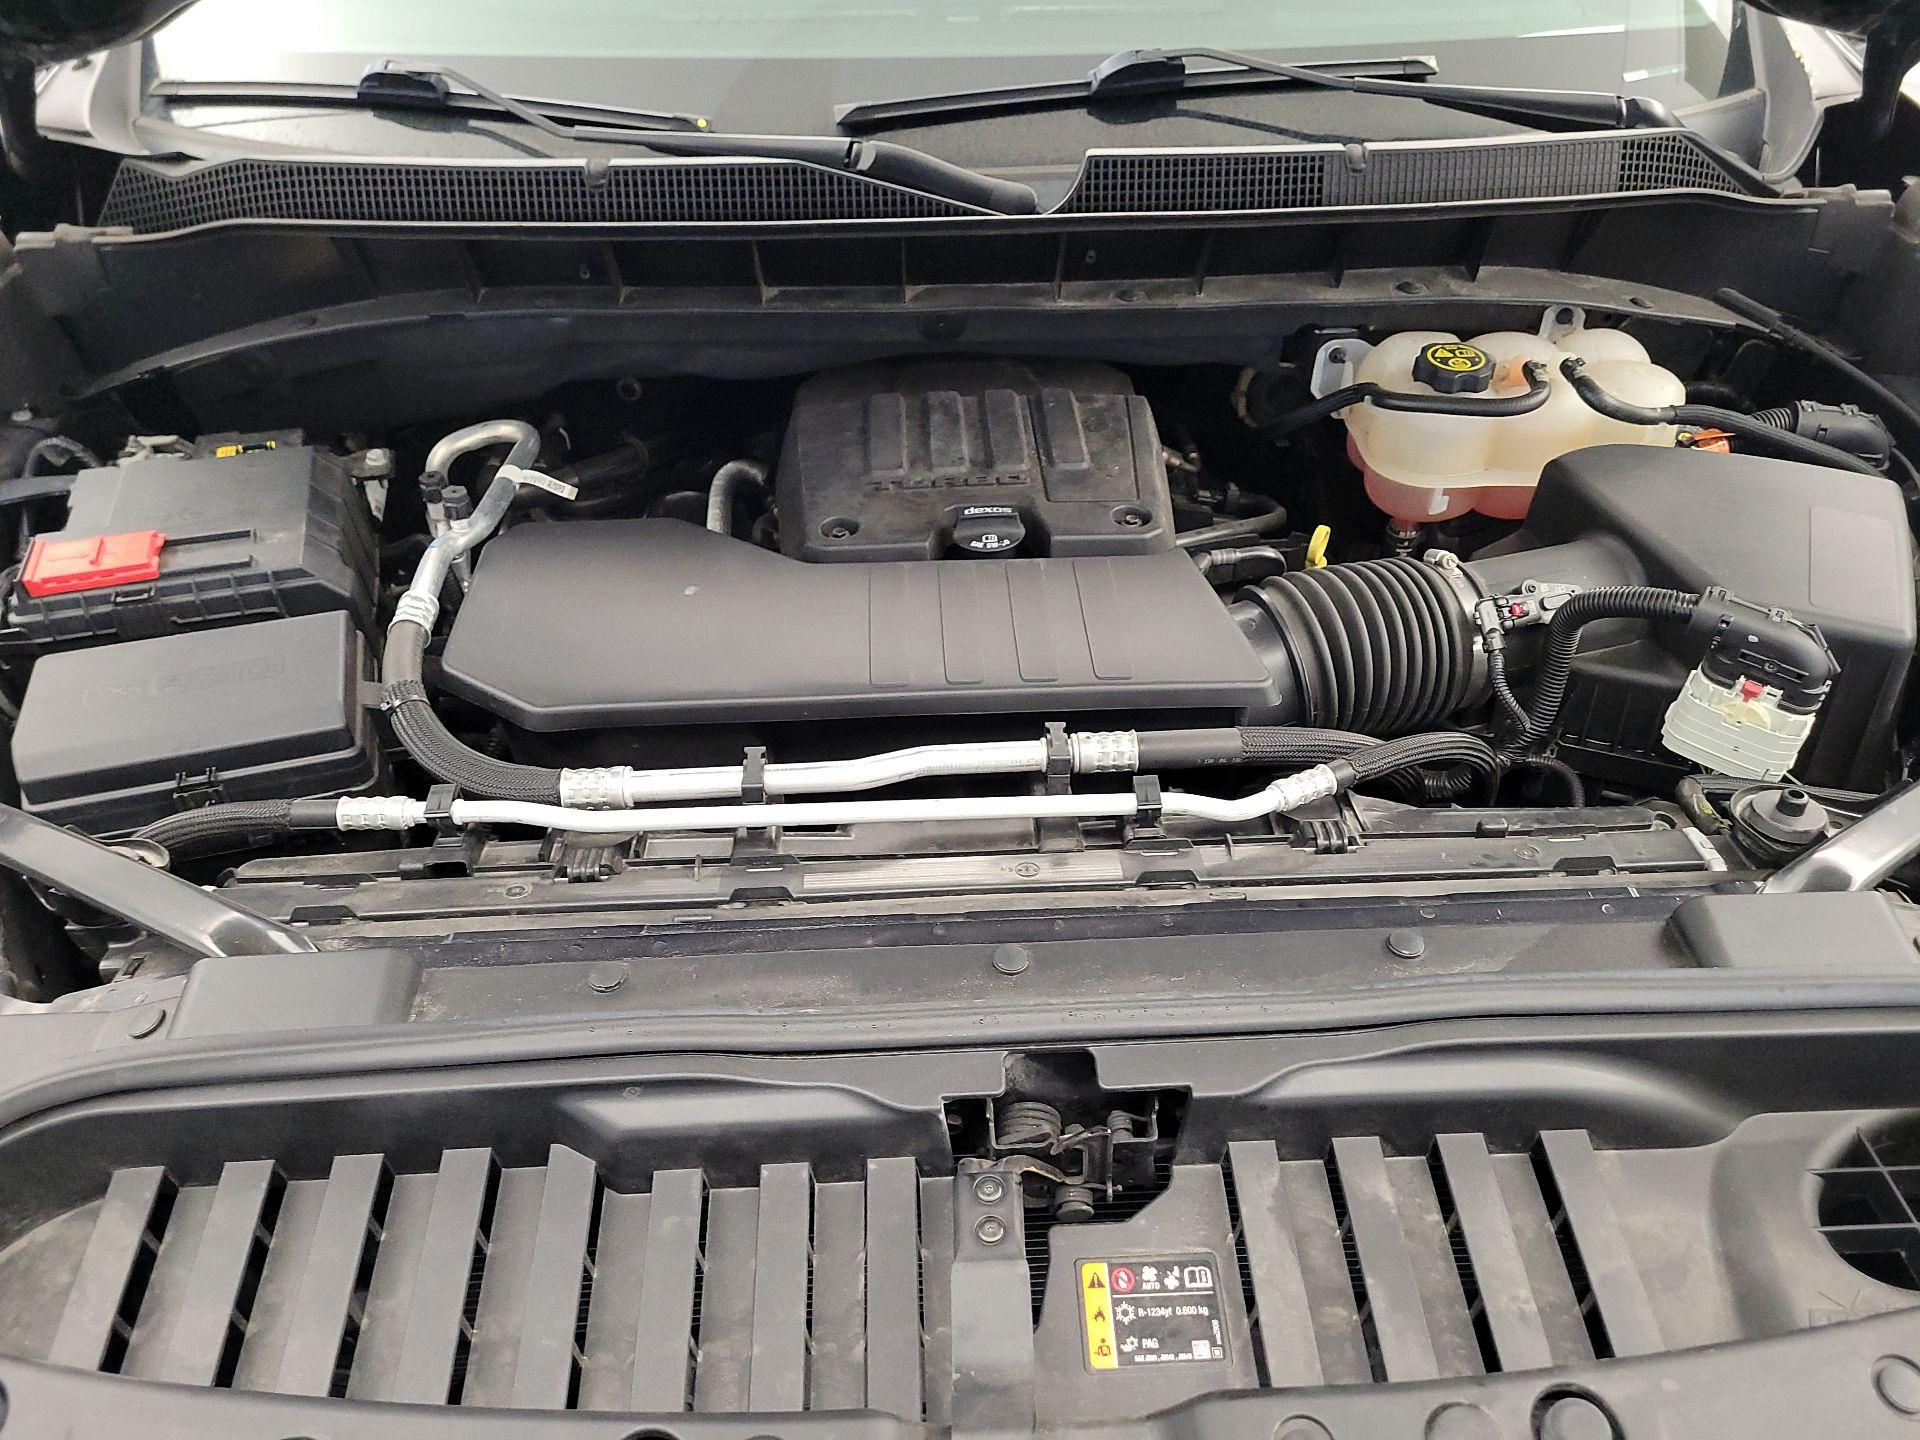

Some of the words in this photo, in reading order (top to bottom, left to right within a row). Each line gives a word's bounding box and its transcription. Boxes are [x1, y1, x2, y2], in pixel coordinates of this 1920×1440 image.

[963, 506, 1013, 515] dexos
[1141, 1281, 1161, 1290] AUTO
[1175, 1305, 1198, 1316] 0.600
[1197, 1304, 1210, 1316] kg
[1141, 1337, 1160, 1349] PAG
